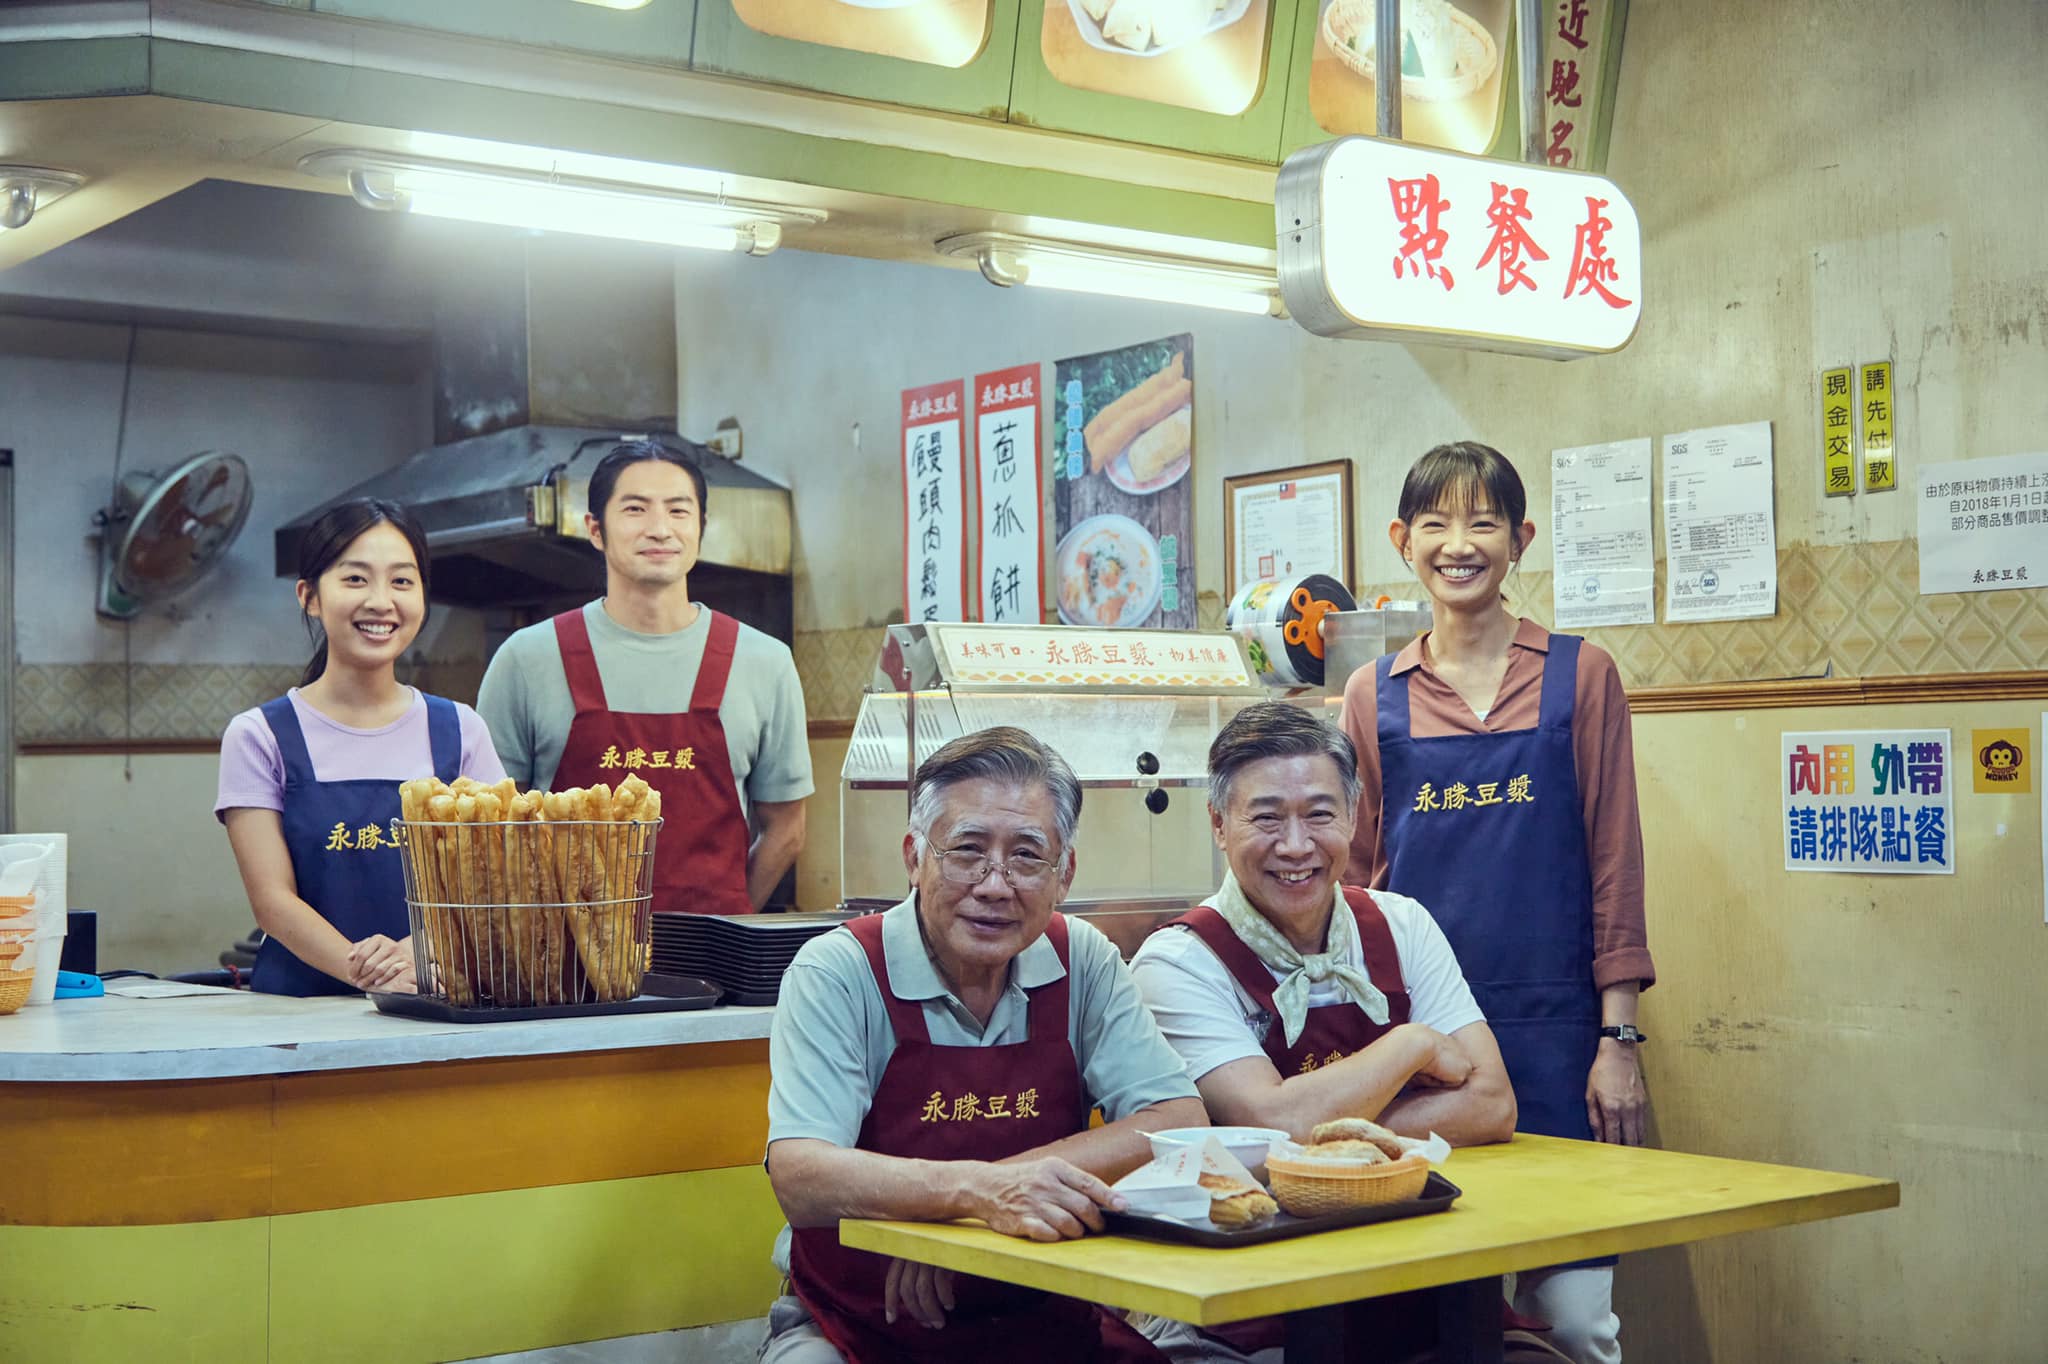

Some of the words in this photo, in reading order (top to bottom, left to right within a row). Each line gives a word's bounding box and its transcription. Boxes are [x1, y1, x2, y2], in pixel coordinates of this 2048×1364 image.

[1387, 173, 1632, 309] 點餐處
[1826, 374, 1850, 487] 現金交易
[1866, 369, 1889, 483] 請先付款
[1671, 443, 1688, 456] SGS
[1047, 640, 1155, 666] 永勝豆漿
[599, 745, 696, 769] 永勝豆漿
[1872, 742, 1943, 795] 外帶
[1412, 774, 1535, 812] 永勝豆漿
[1789, 805, 1946, 866] 請排隊點餐
[920, 1088, 1040, 1122] 永勝豆漿
